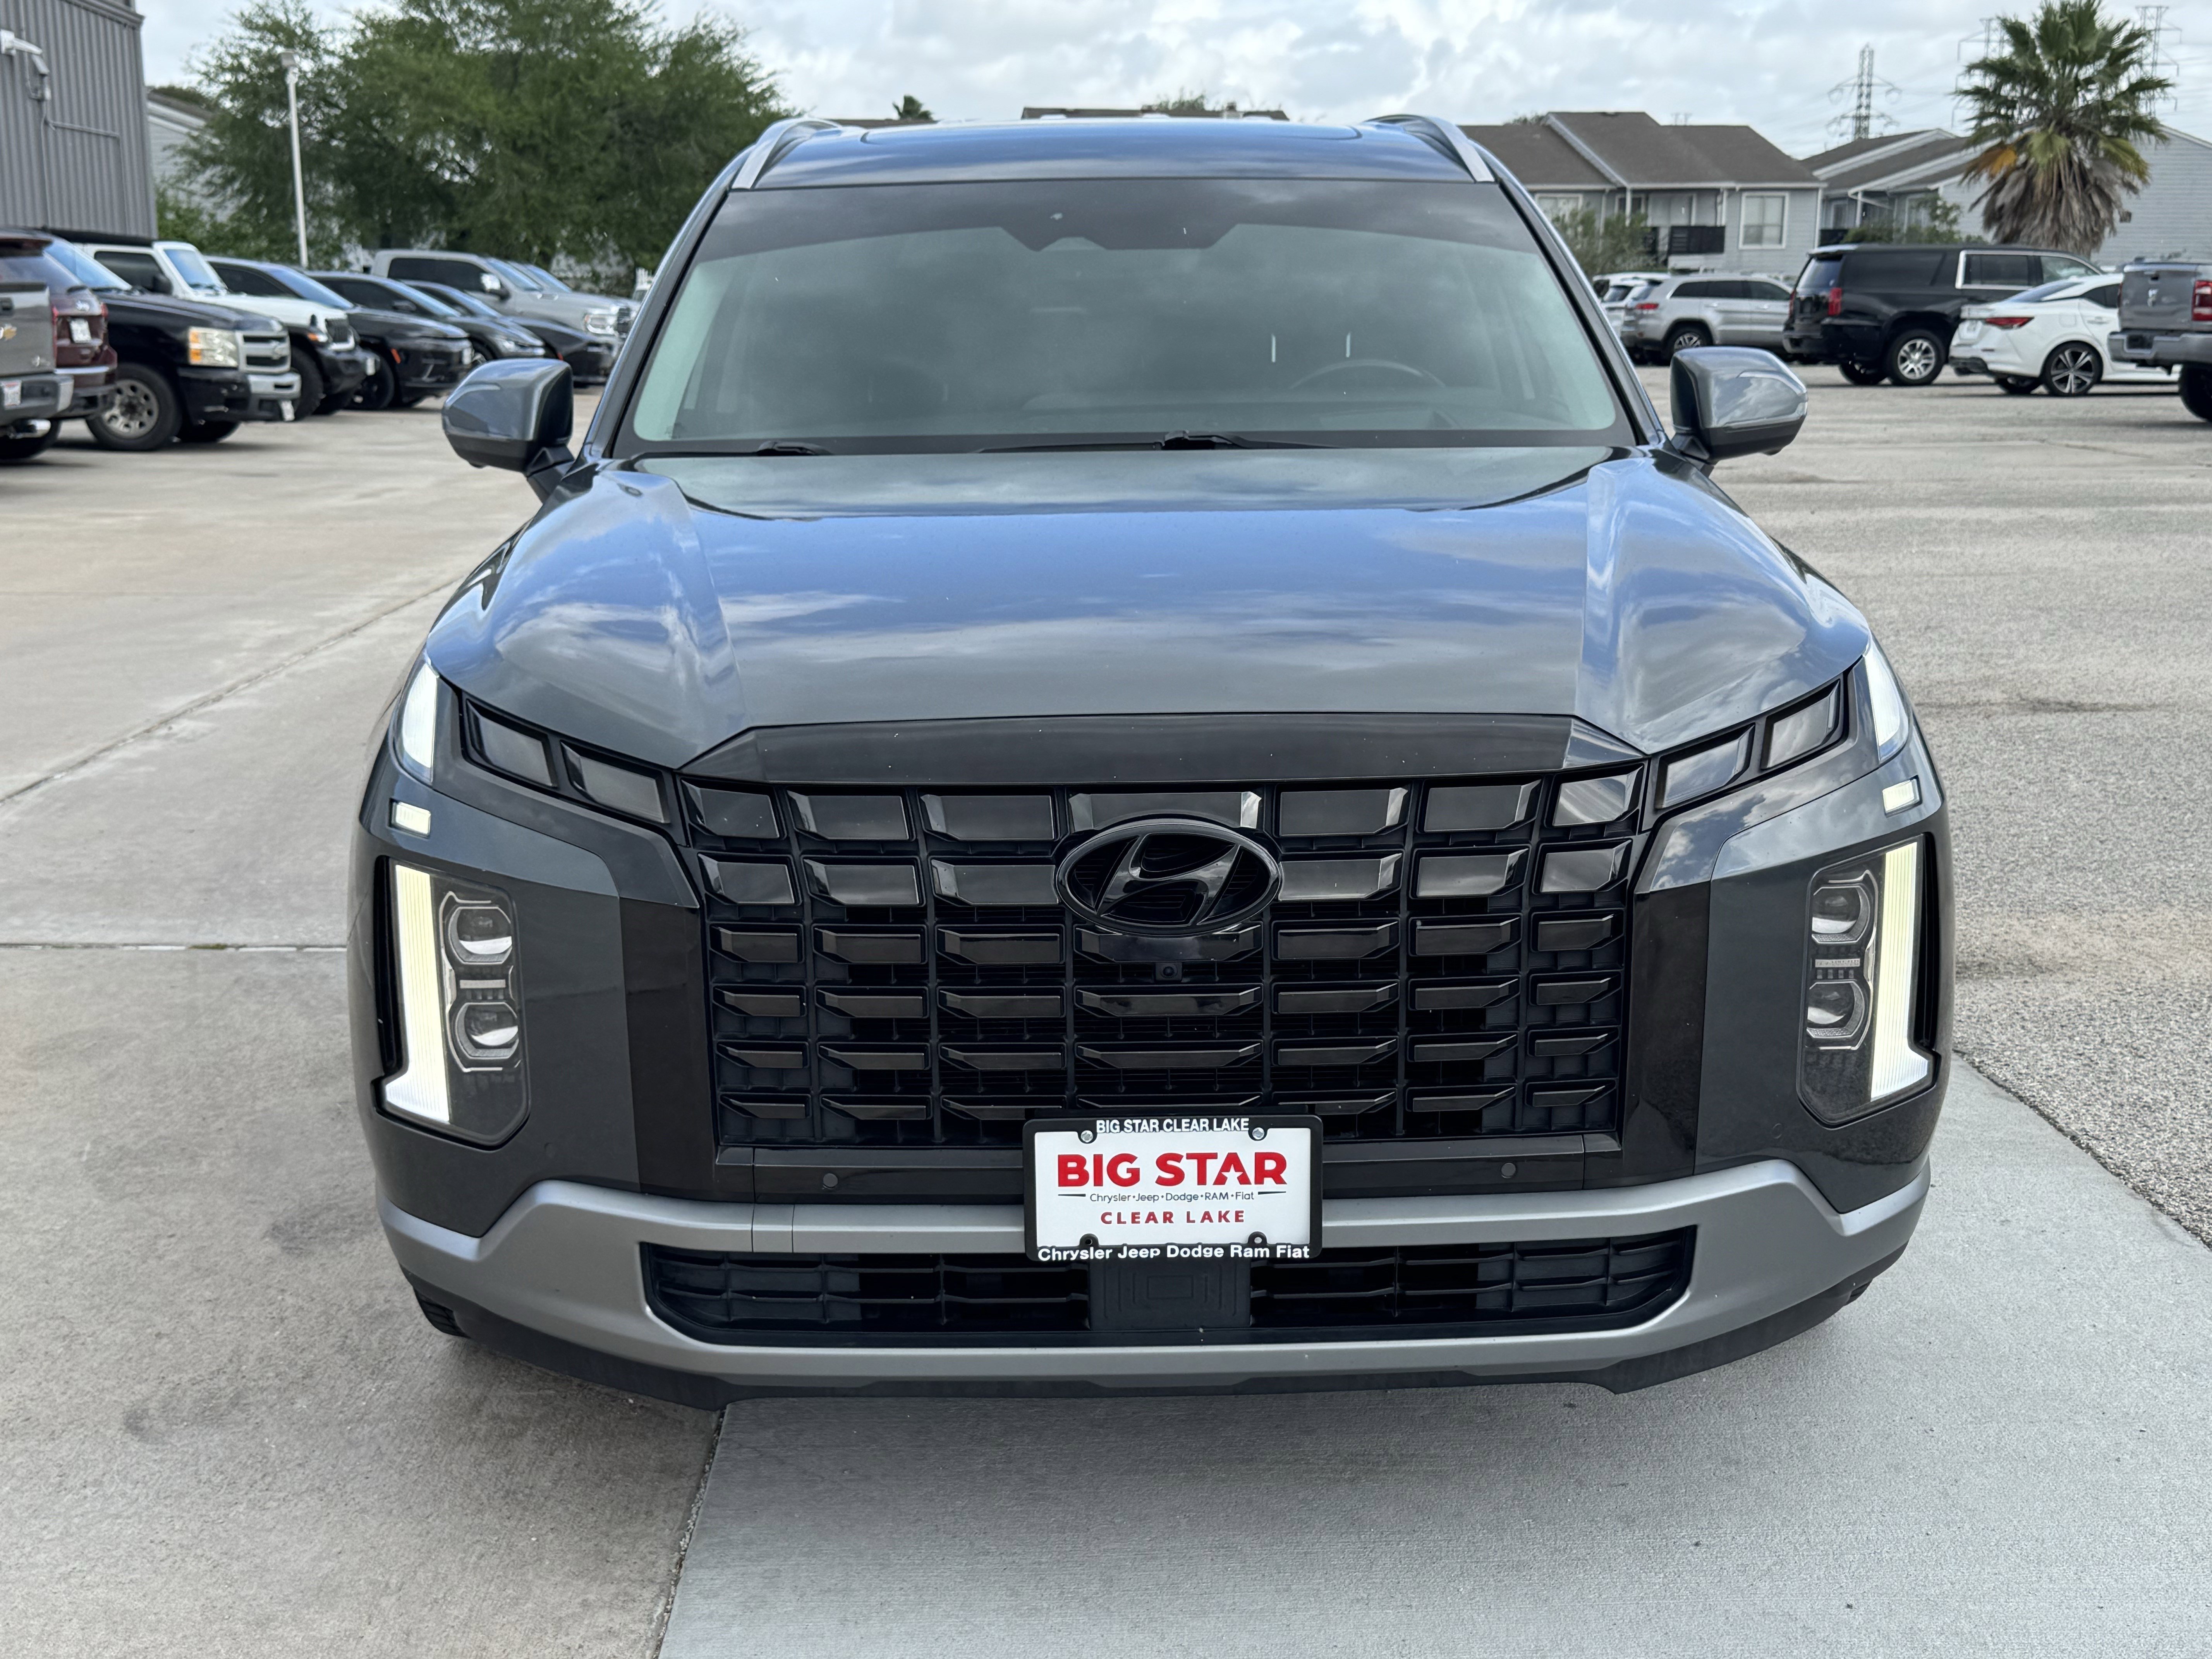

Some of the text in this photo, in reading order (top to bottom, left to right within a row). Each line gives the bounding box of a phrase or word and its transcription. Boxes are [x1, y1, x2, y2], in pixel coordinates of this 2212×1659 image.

[1096, 1118, 1249, 1133] BIG STAR CLEAR LAKE
[1058, 1152, 1287, 1187] BIG STAR
[1090, 1193, 1131, 1204] Chrysler
[1135, 1193, 1159, 1203] Jeep
[1166, 1192, 1199, 1202] Dodge
[1205, 1192, 1229, 1200] RAM
[1101, 1210, 1244, 1224] CLEAR LAKE
[1038, 1244, 1310, 1262] Chrysler Jeep Dodge Ram Fiat
